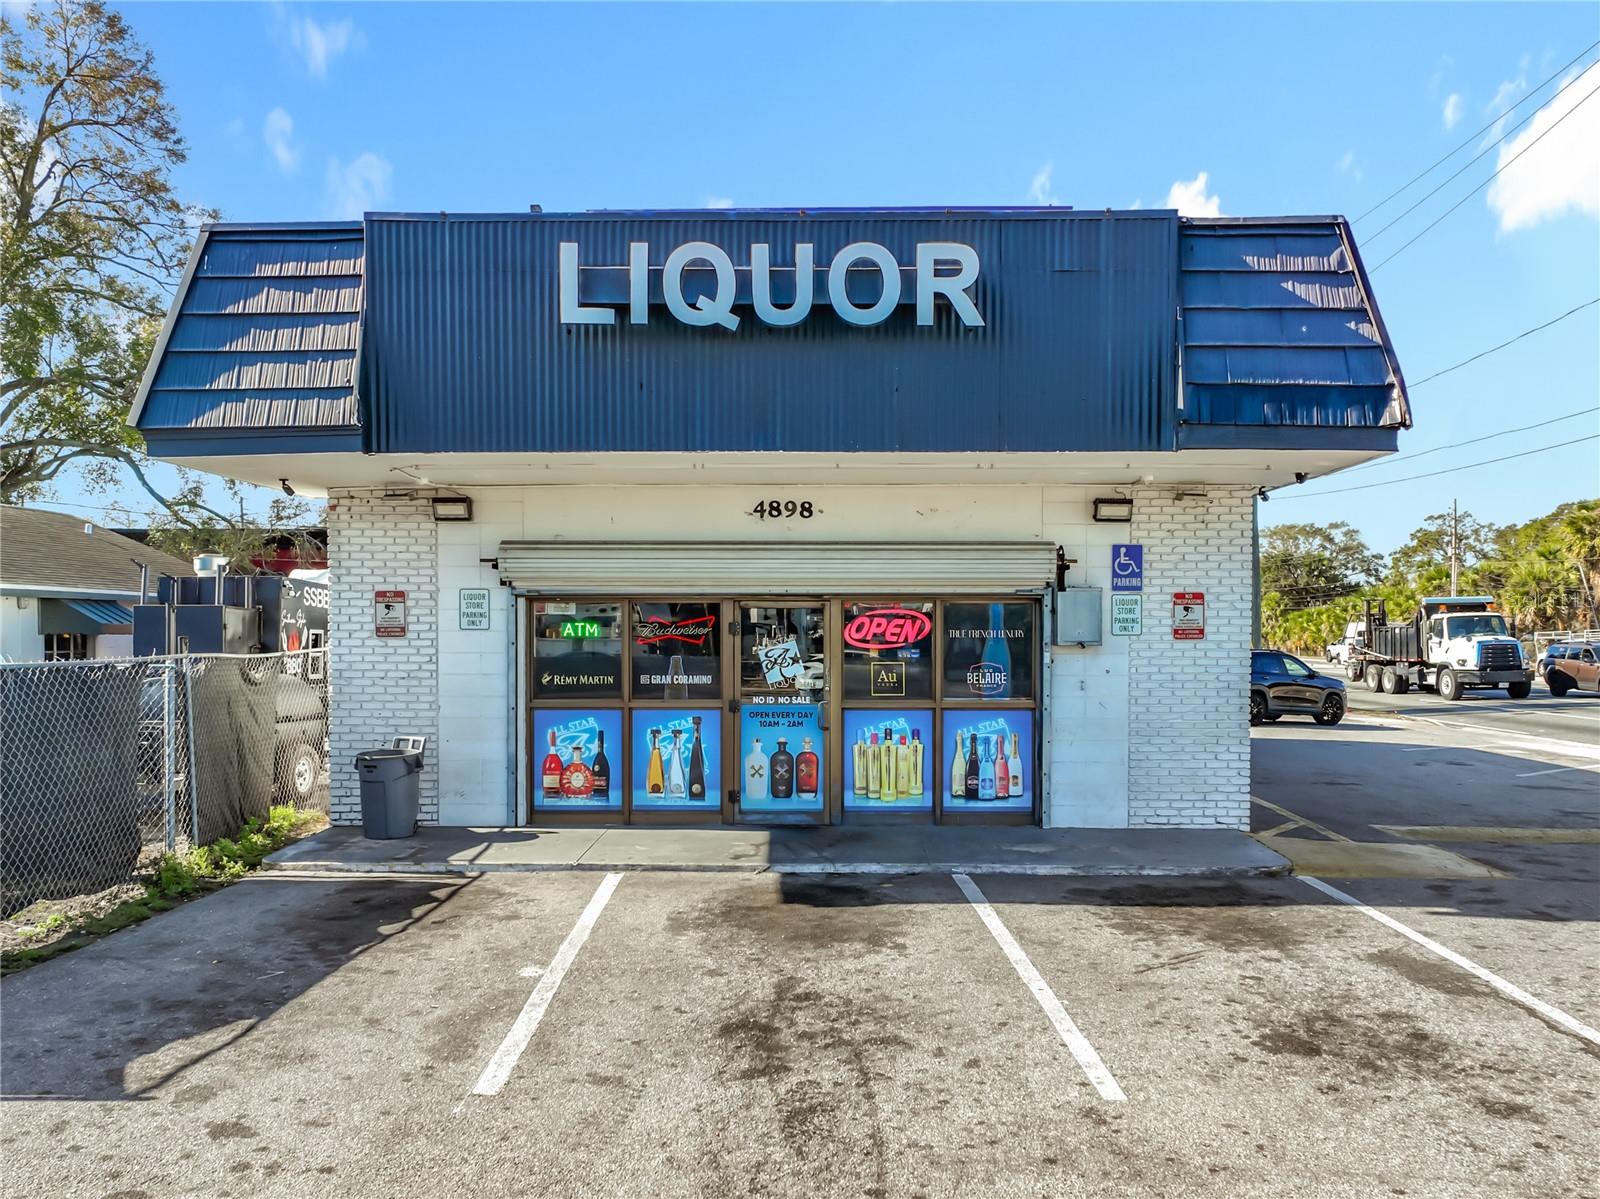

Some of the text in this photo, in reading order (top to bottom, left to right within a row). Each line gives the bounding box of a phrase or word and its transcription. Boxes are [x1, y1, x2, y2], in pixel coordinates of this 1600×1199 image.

[559, 241, 985, 331] LIQUOR
[753, 500, 813, 519] 4898
[1113, 577, 1141, 587] PARKING
[463, 593, 486, 601] LIQUOR
[1115, 598, 1139, 606] LIQUOR
[462, 611, 487, 619] PARKING
[1117, 607, 1136, 615] STORE
[563, 622, 598, 637] ATM
[637, 623, 713, 636] Budweiser
[850, 616, 922, 643] OPEN
[948, 629, 1025, 639] TRUE FRENCH LUXURY
[553, 674, 614, 685] RÉMY MARTIN
[651, 674, 712, 685] GRAN CORAMINO
[877, 669, 898, 683] Au
[966, 672, 1007, 684] BELAIRE
[568, 717, 597, 732] STAR
[978, 717, 1006, 732] STAR
